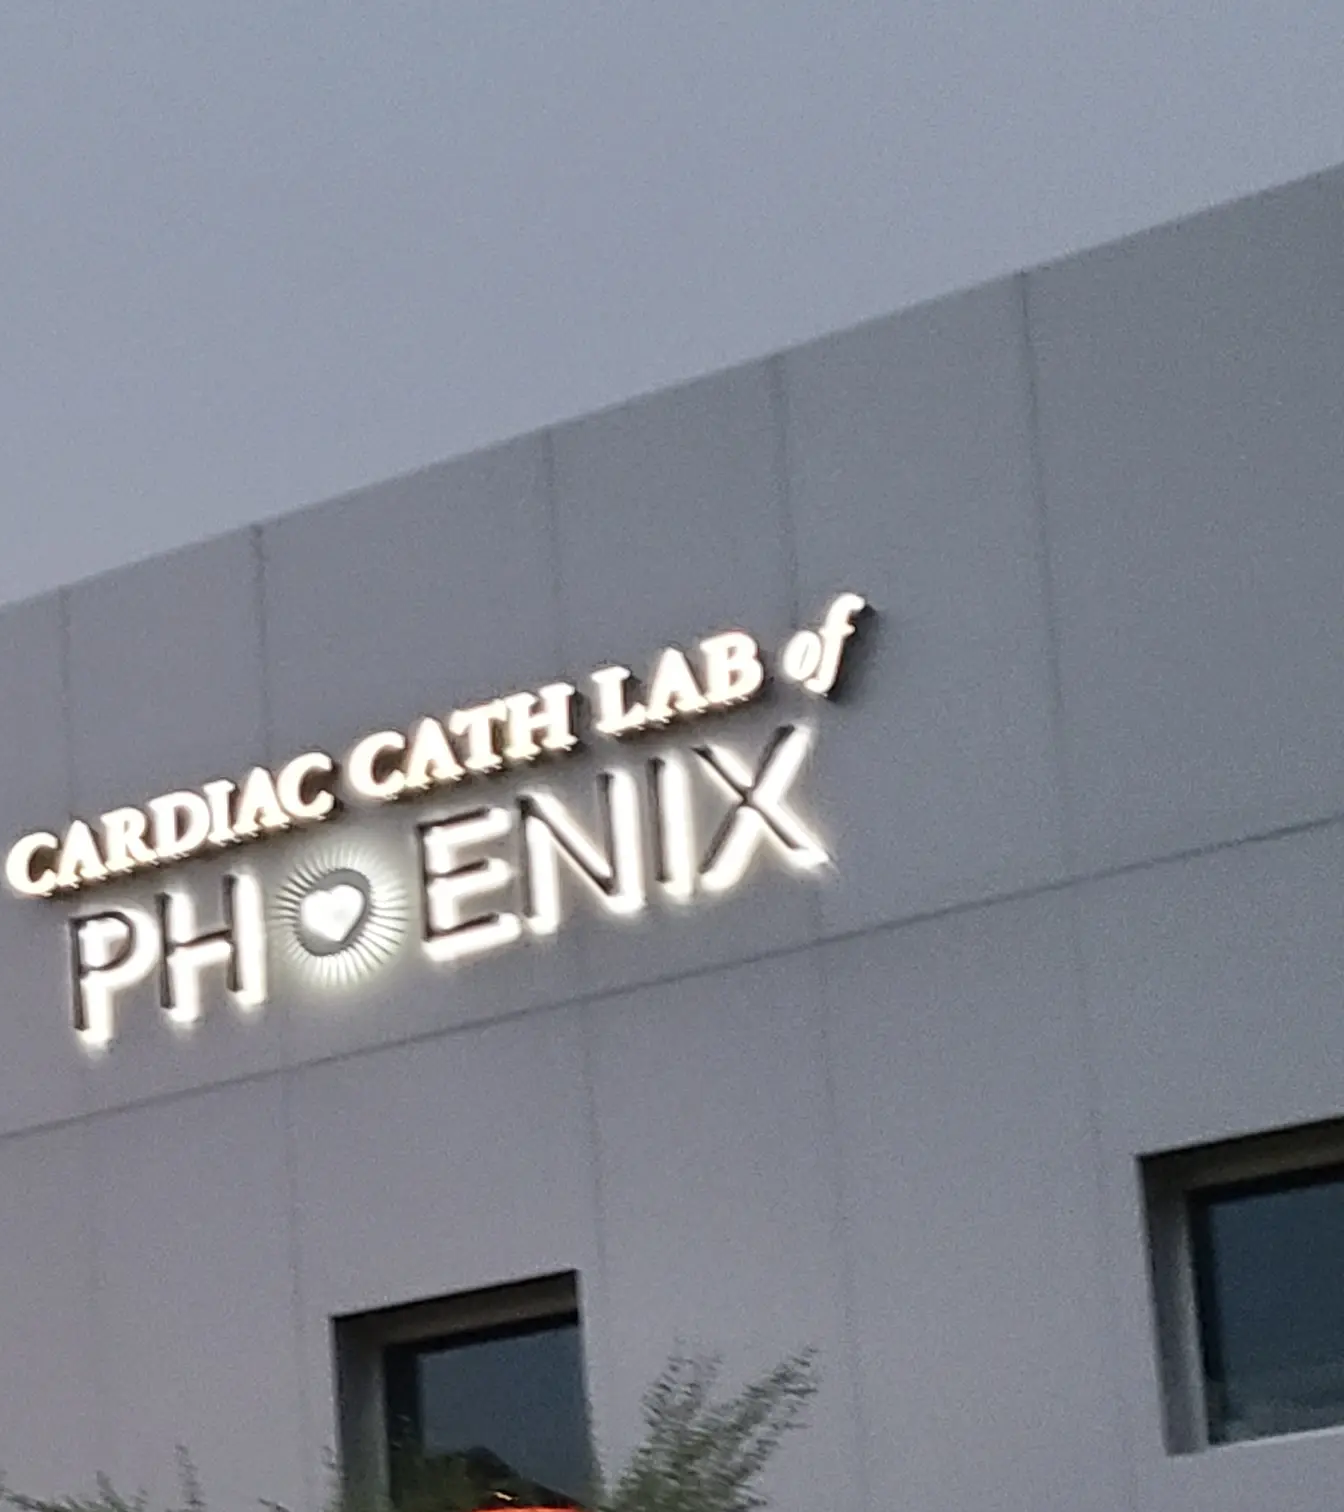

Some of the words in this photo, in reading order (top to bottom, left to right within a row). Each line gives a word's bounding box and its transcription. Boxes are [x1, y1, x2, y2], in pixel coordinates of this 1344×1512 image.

[5, 752, 335, 897] CARDIAC
[348, 683, 578, 800] CATH
[591, 631, 765, 737] LAB
[783, 593, 868, 699] of
